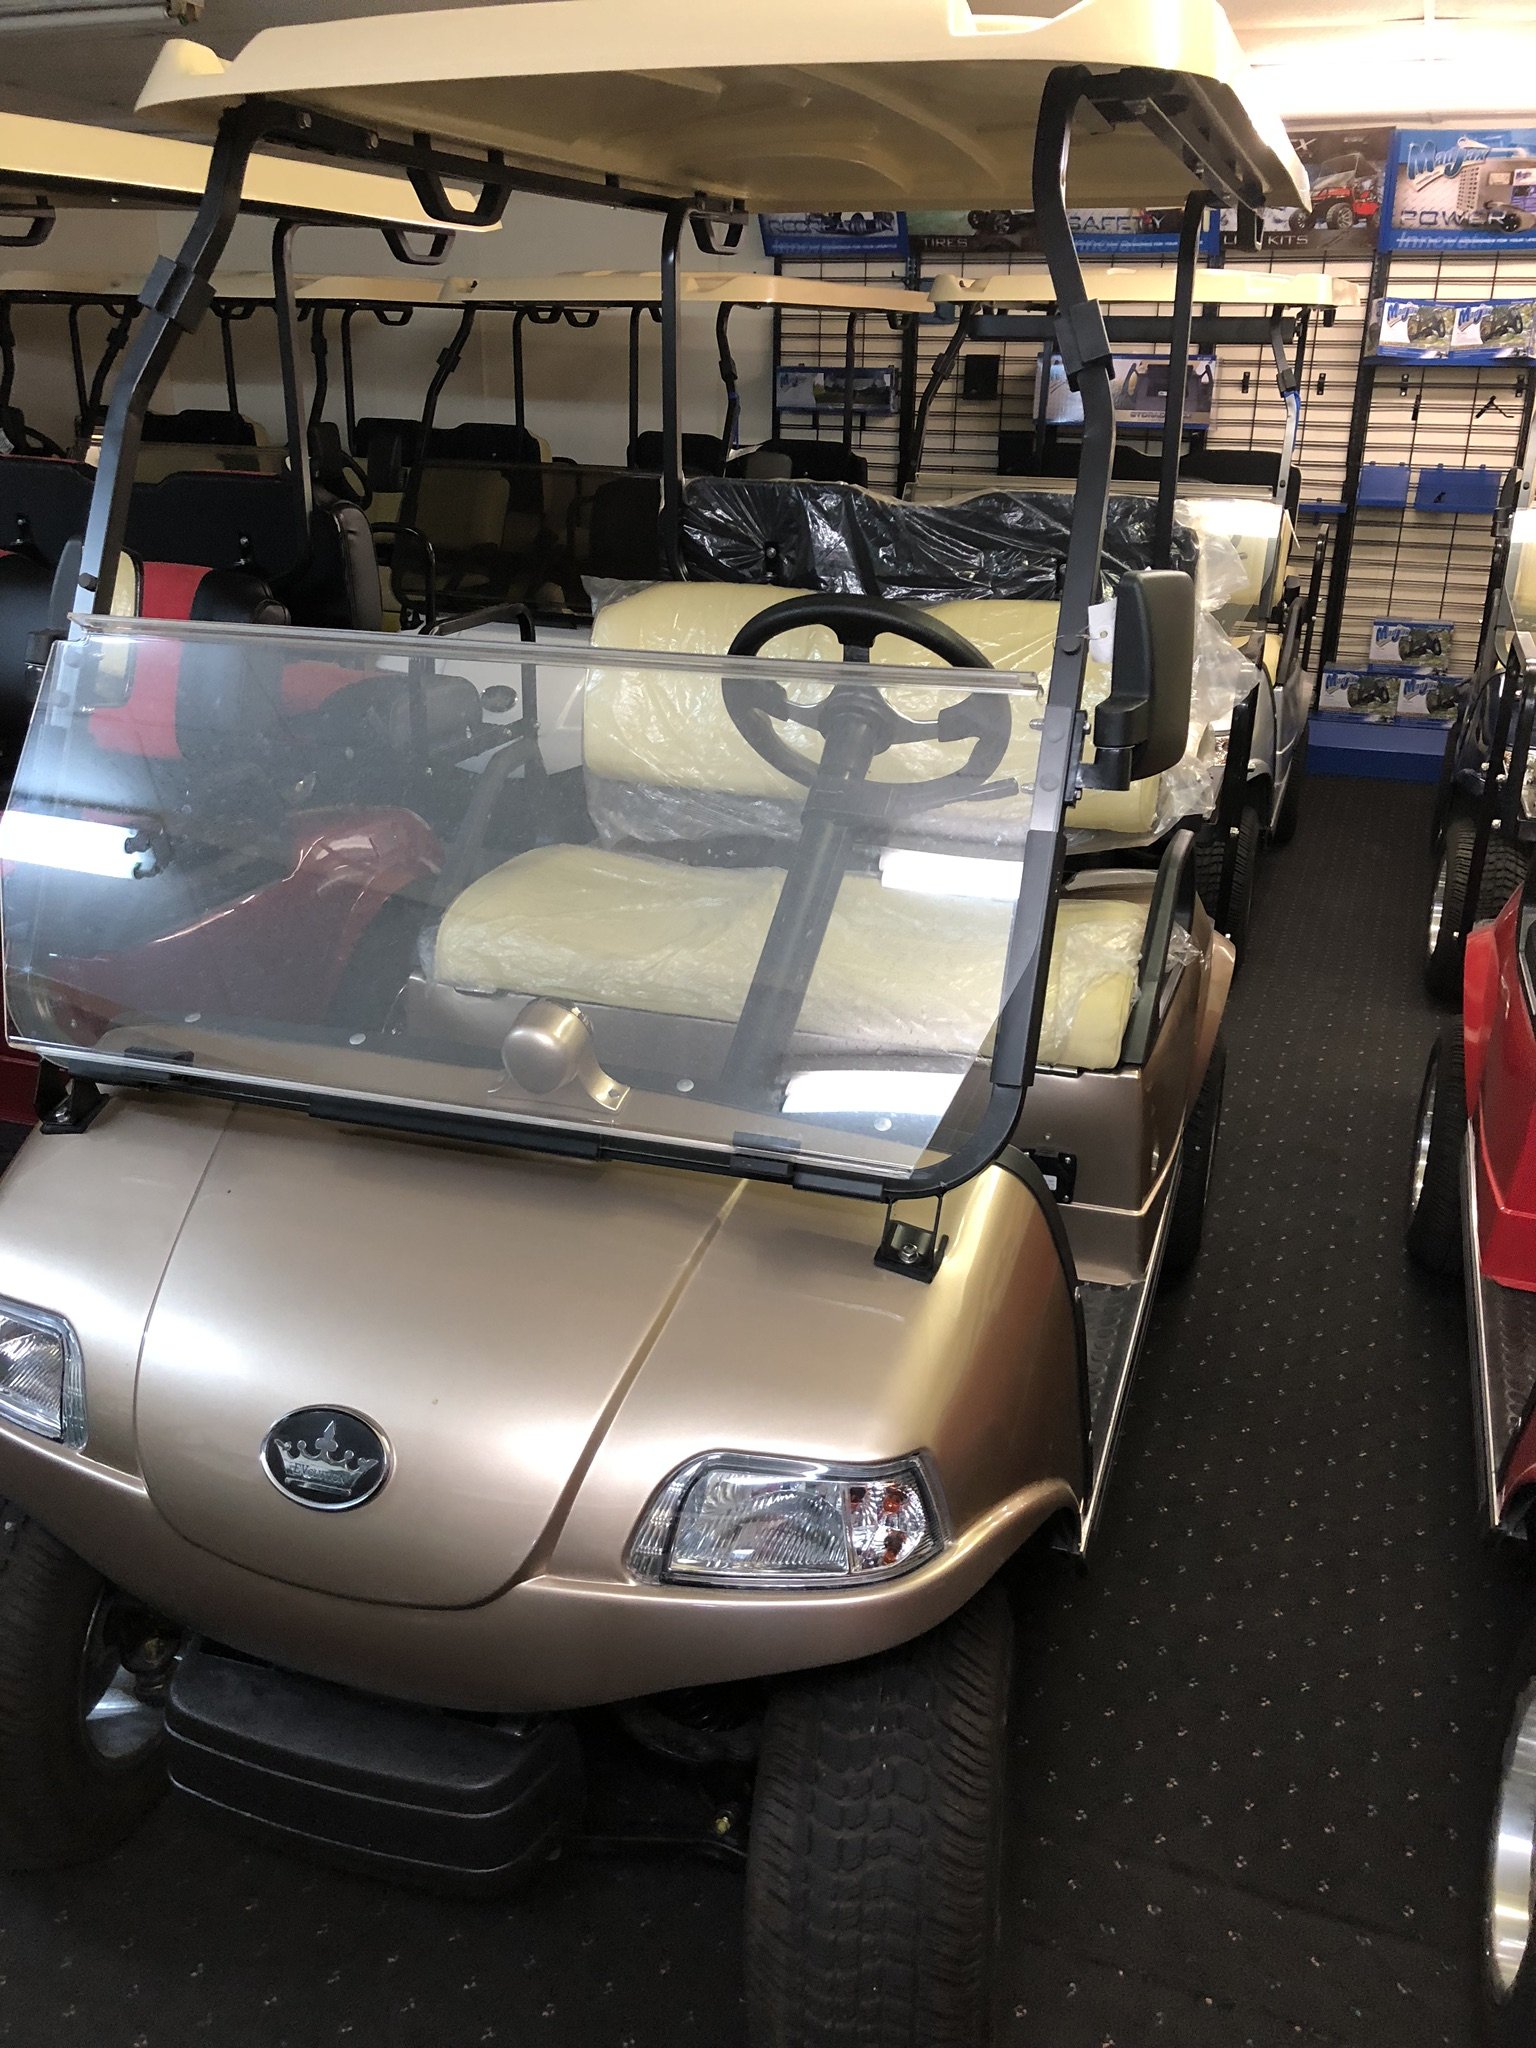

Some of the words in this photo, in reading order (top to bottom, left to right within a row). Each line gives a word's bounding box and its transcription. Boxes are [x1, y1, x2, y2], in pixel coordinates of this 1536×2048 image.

[1069, 215, 1166, 231] SAFETY
[1400, 210, 1508, 226] POWER
[923, 238, 968, 248] TIRES
[1268, 235, 1308, 245] KITS
